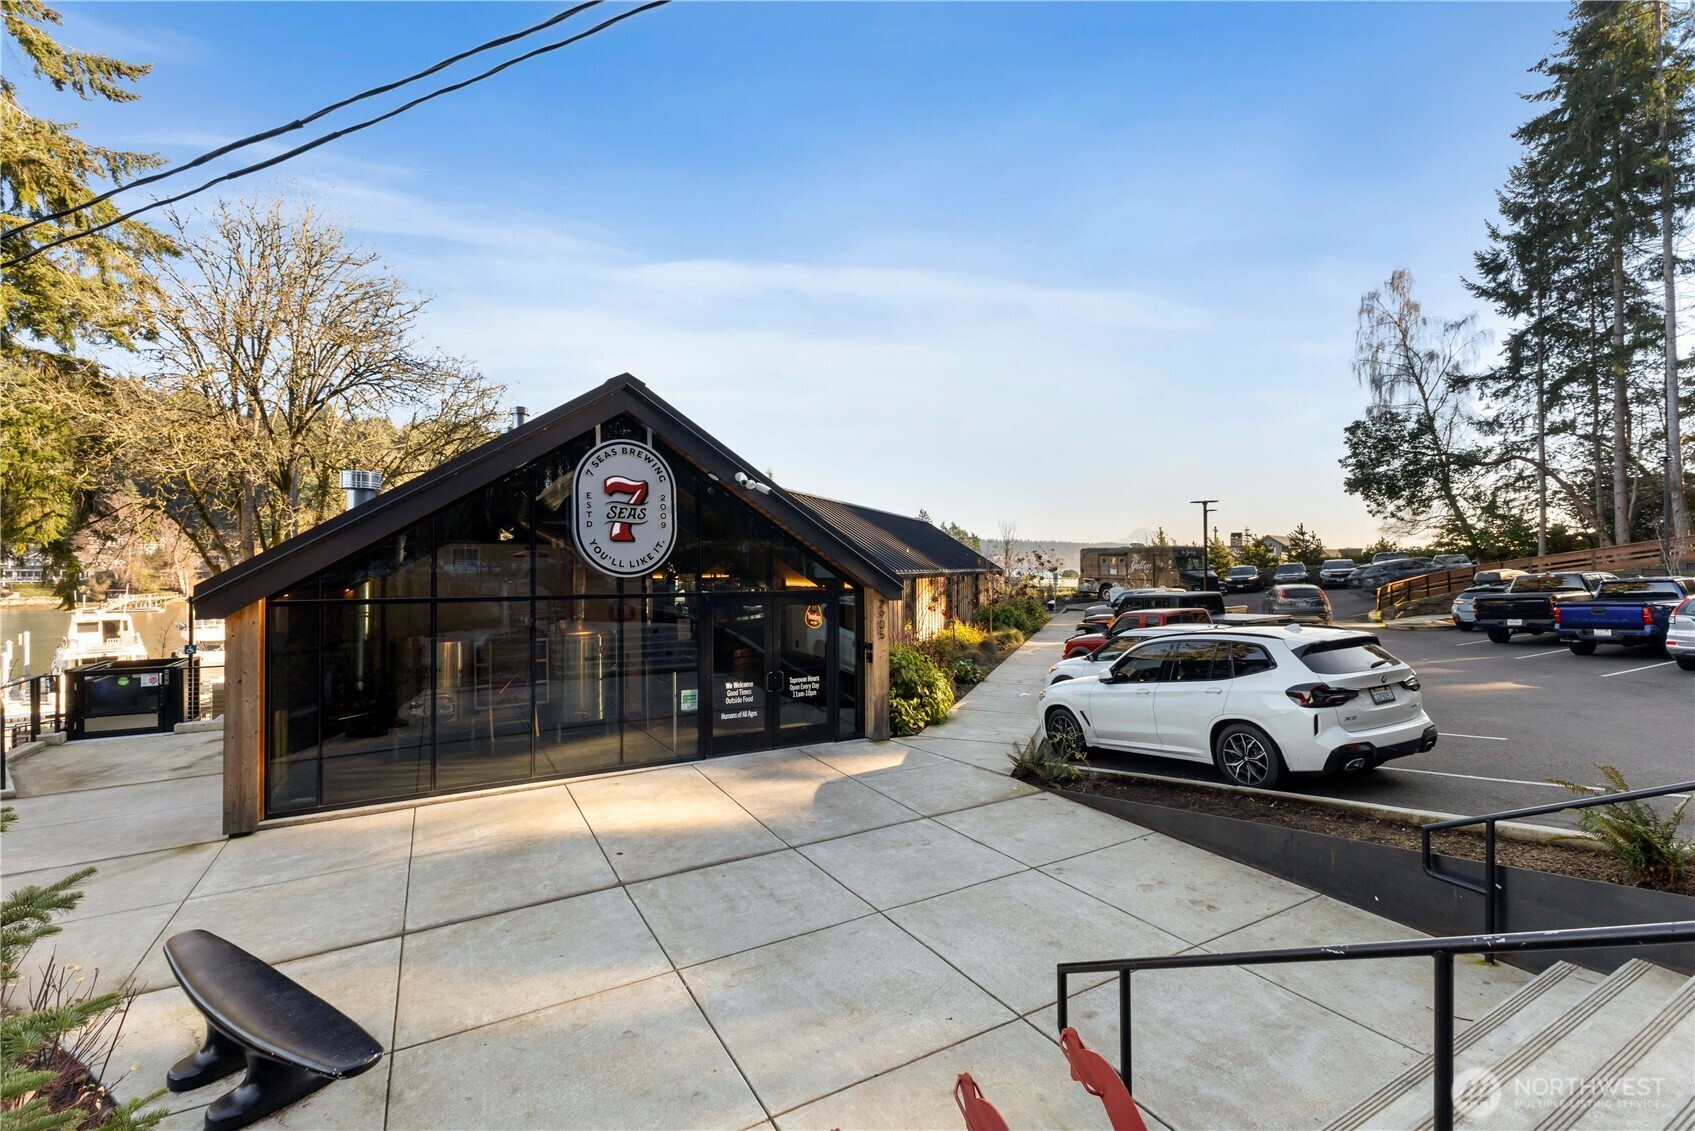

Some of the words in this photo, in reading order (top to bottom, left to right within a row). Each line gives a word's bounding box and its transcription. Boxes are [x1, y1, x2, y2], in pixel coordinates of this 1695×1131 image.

[586, 469, 594, 477] 7
[591, 447, 618, 468] SEAS
[621, 447, 666, 483] BREWING
[603, 475, 649, 542] 7
[606, 505, 647, 520] SEAS
[589, 538, 625, 568] YOU'LL
[629, 555, 655, 568] LIKE
[653, 540, 665, 553] IT.
[877, 599, 885, 640] 2905
[733, 681, 754, 689] Welcome
[789, 684, 800, 692] Open
[800, 683, 811, 691] Every
[811, 682, 820, 690] Day
[726, 689, 738, 697] Good
[738, 688, 752, 696] Times
[725, 696, 742, 704] Outside
[742, 695, 754, 703] Food
[720, 712, 737, 720] Humans
[737, 710, 742, 718] of
[748, 710, 758, 719] Ages
